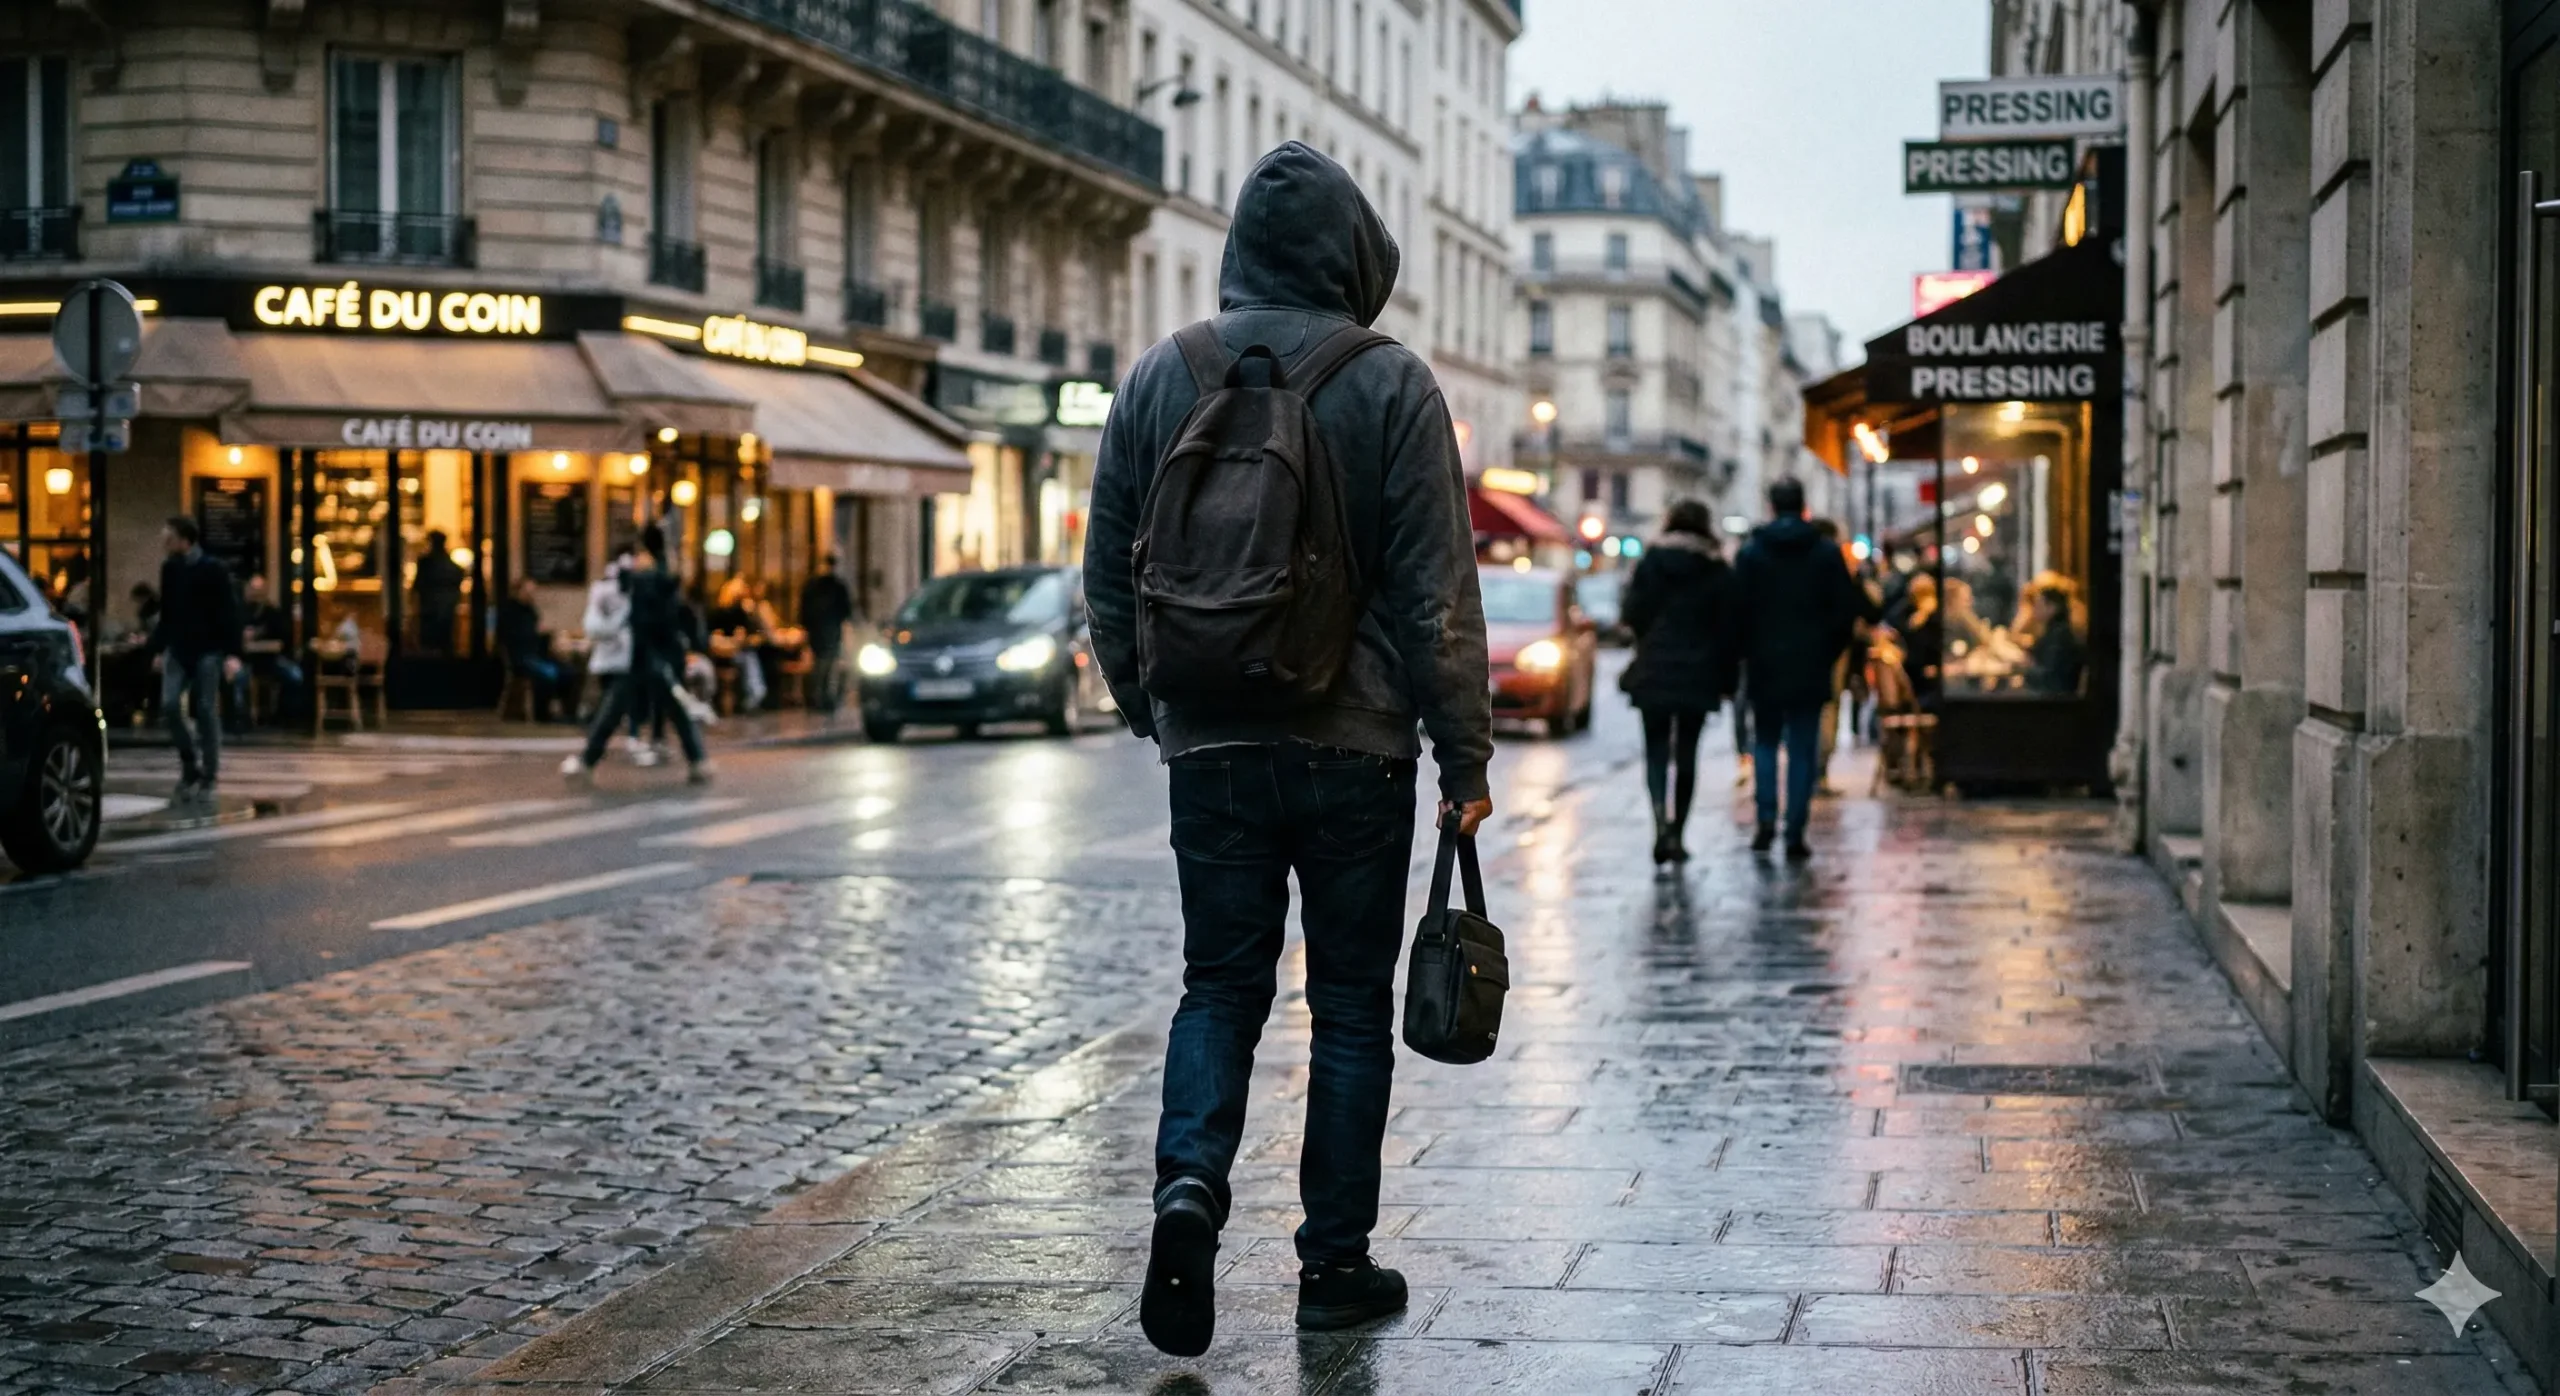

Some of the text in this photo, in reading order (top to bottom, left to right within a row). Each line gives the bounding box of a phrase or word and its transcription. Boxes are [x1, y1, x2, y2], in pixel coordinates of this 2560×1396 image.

[1944, 88, 2112, 124] PRESSING
[1908, 147, 2069, 184] PRESSING
[254, 281, 541, 334] CAFÉ DU COIN
[1906, 322, 2106, 356] BOULANGERIE
[1911, 364, 2096, 398] PRESSING
[341, 415, 533, 449] CAFÉ DU COIN
